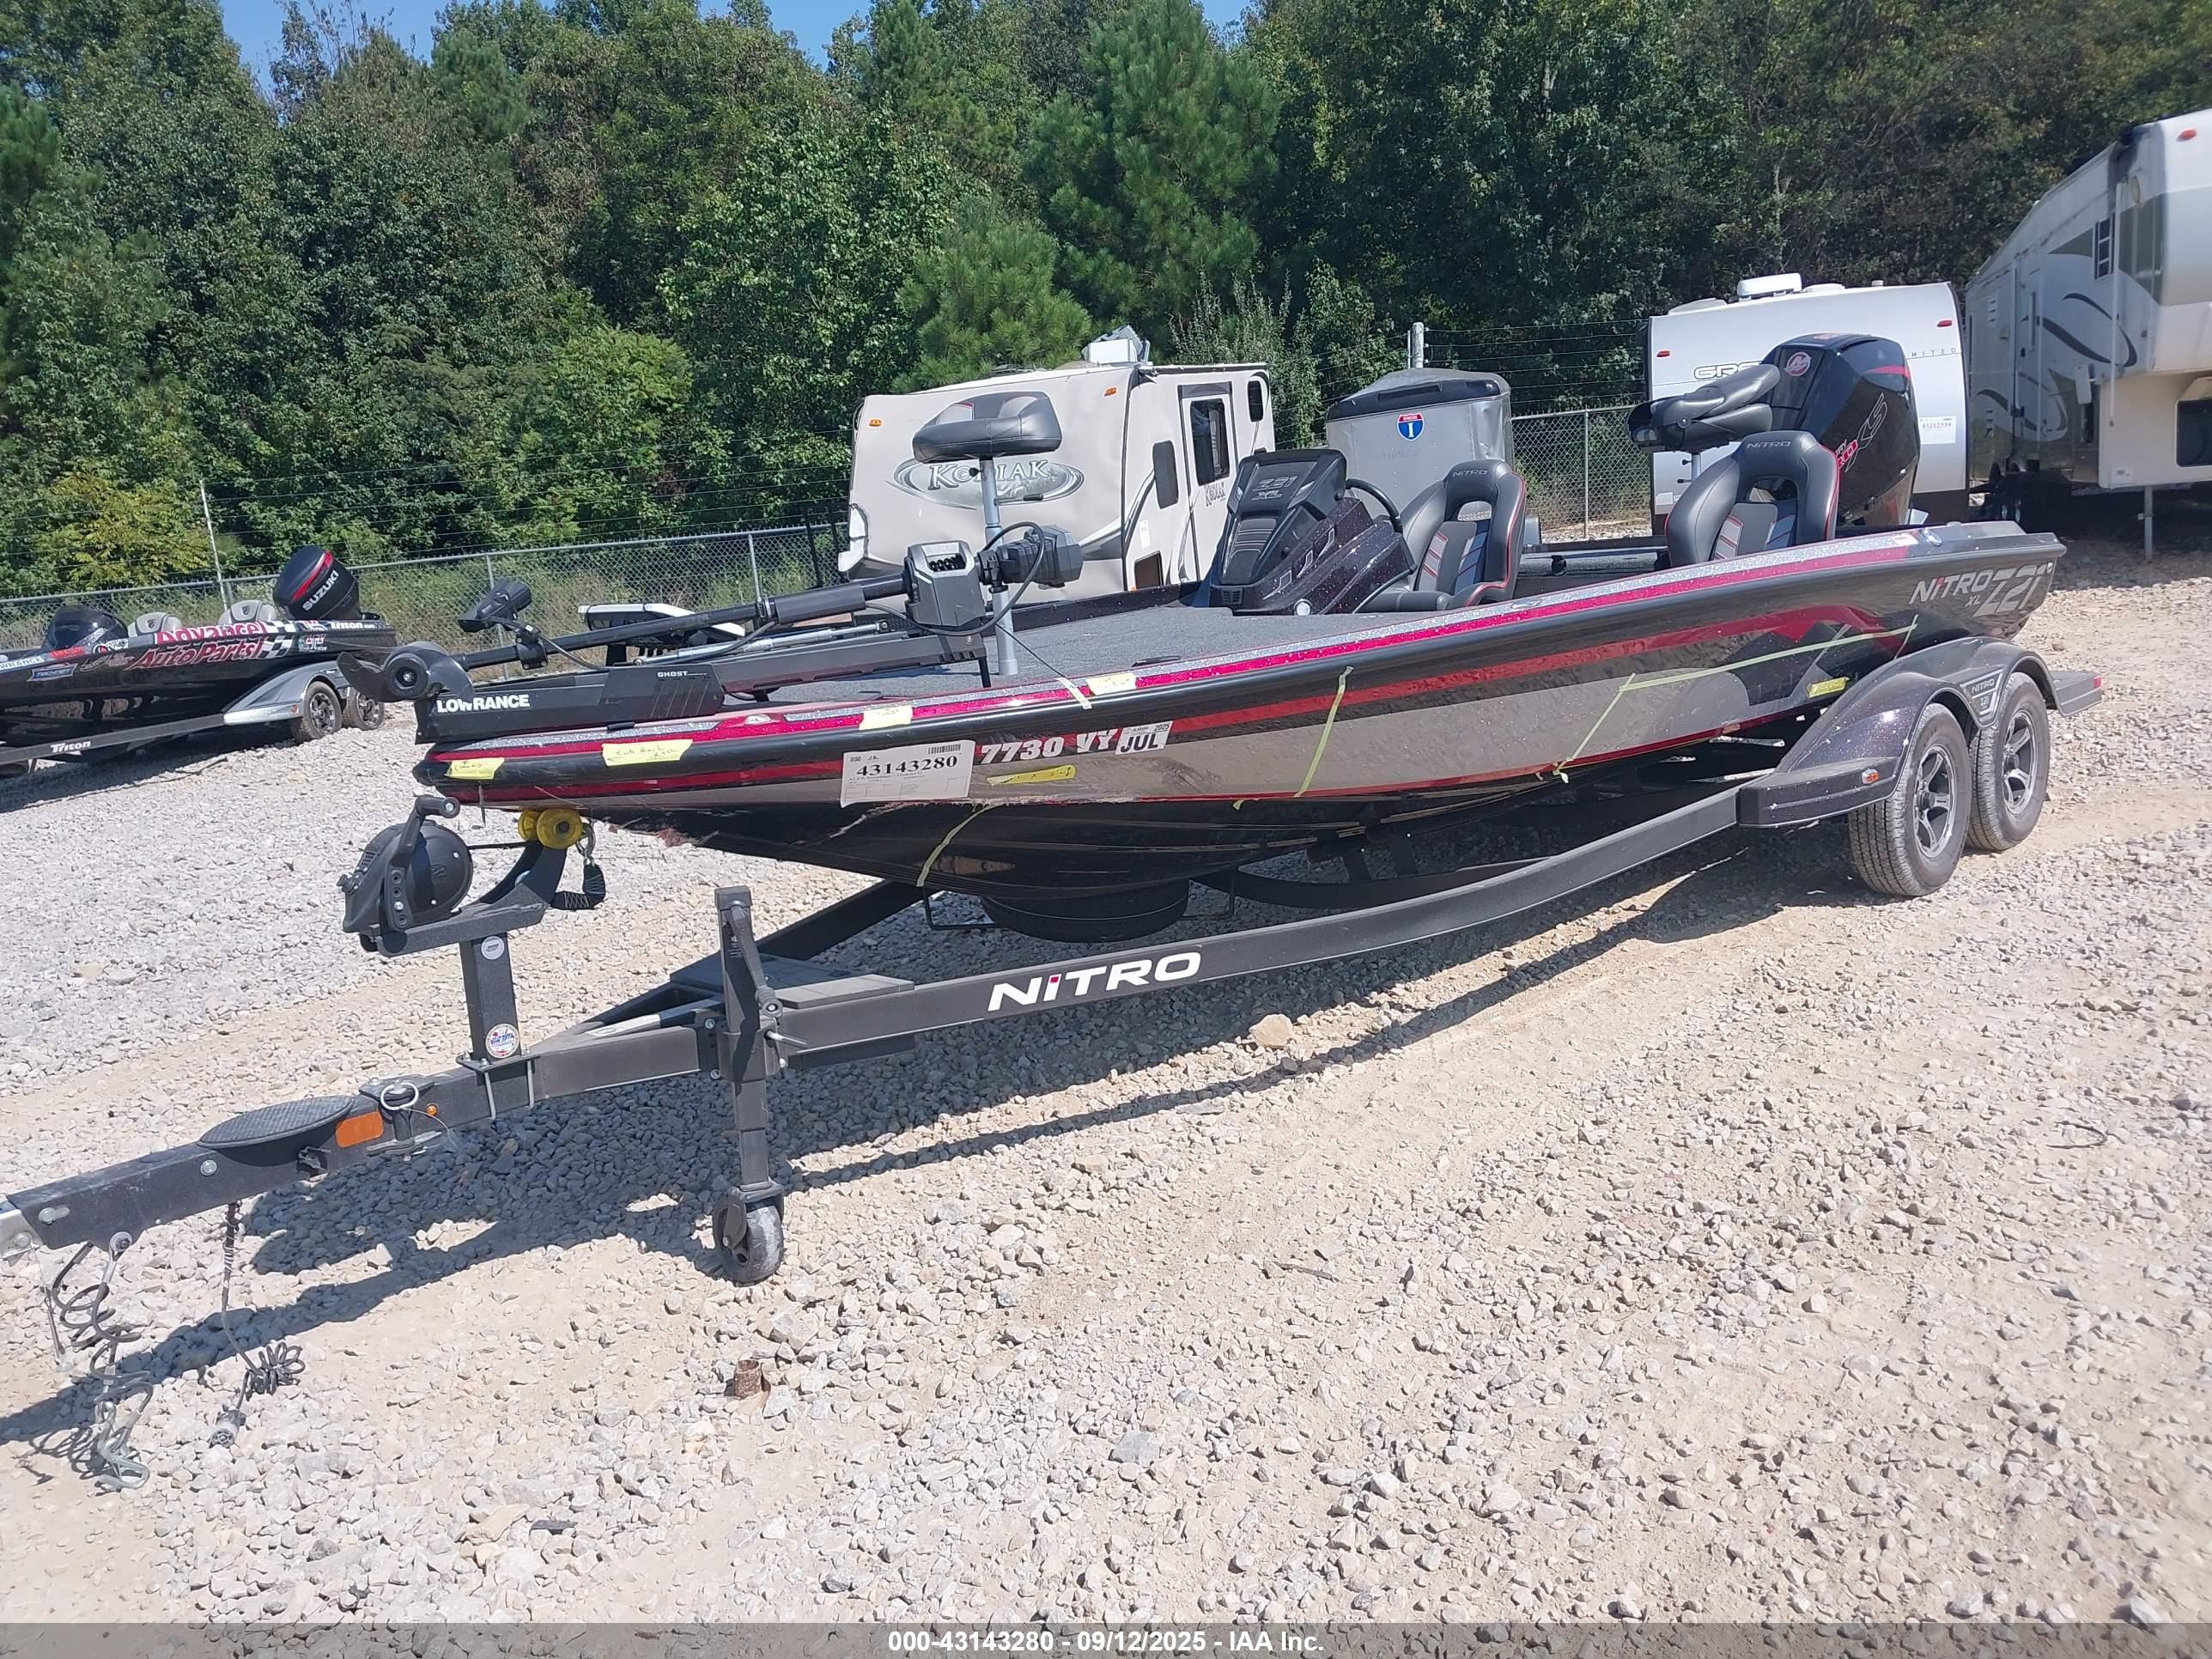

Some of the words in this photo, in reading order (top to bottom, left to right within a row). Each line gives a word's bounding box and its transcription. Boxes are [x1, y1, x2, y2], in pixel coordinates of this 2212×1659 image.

[301, 569, 339, 611] SUZUKI
[1965, 595, 1981, 607] XL
[436, 694, 531, 713] LOWRANCE
[50, 741, 91, 753] Triton
[981, 737, 1065, 764] 7730
[1077, 728, 1118, 753] VY
[1121, 733, 1158, 752] JUL
[856, 756, 957, 776] 43143280
